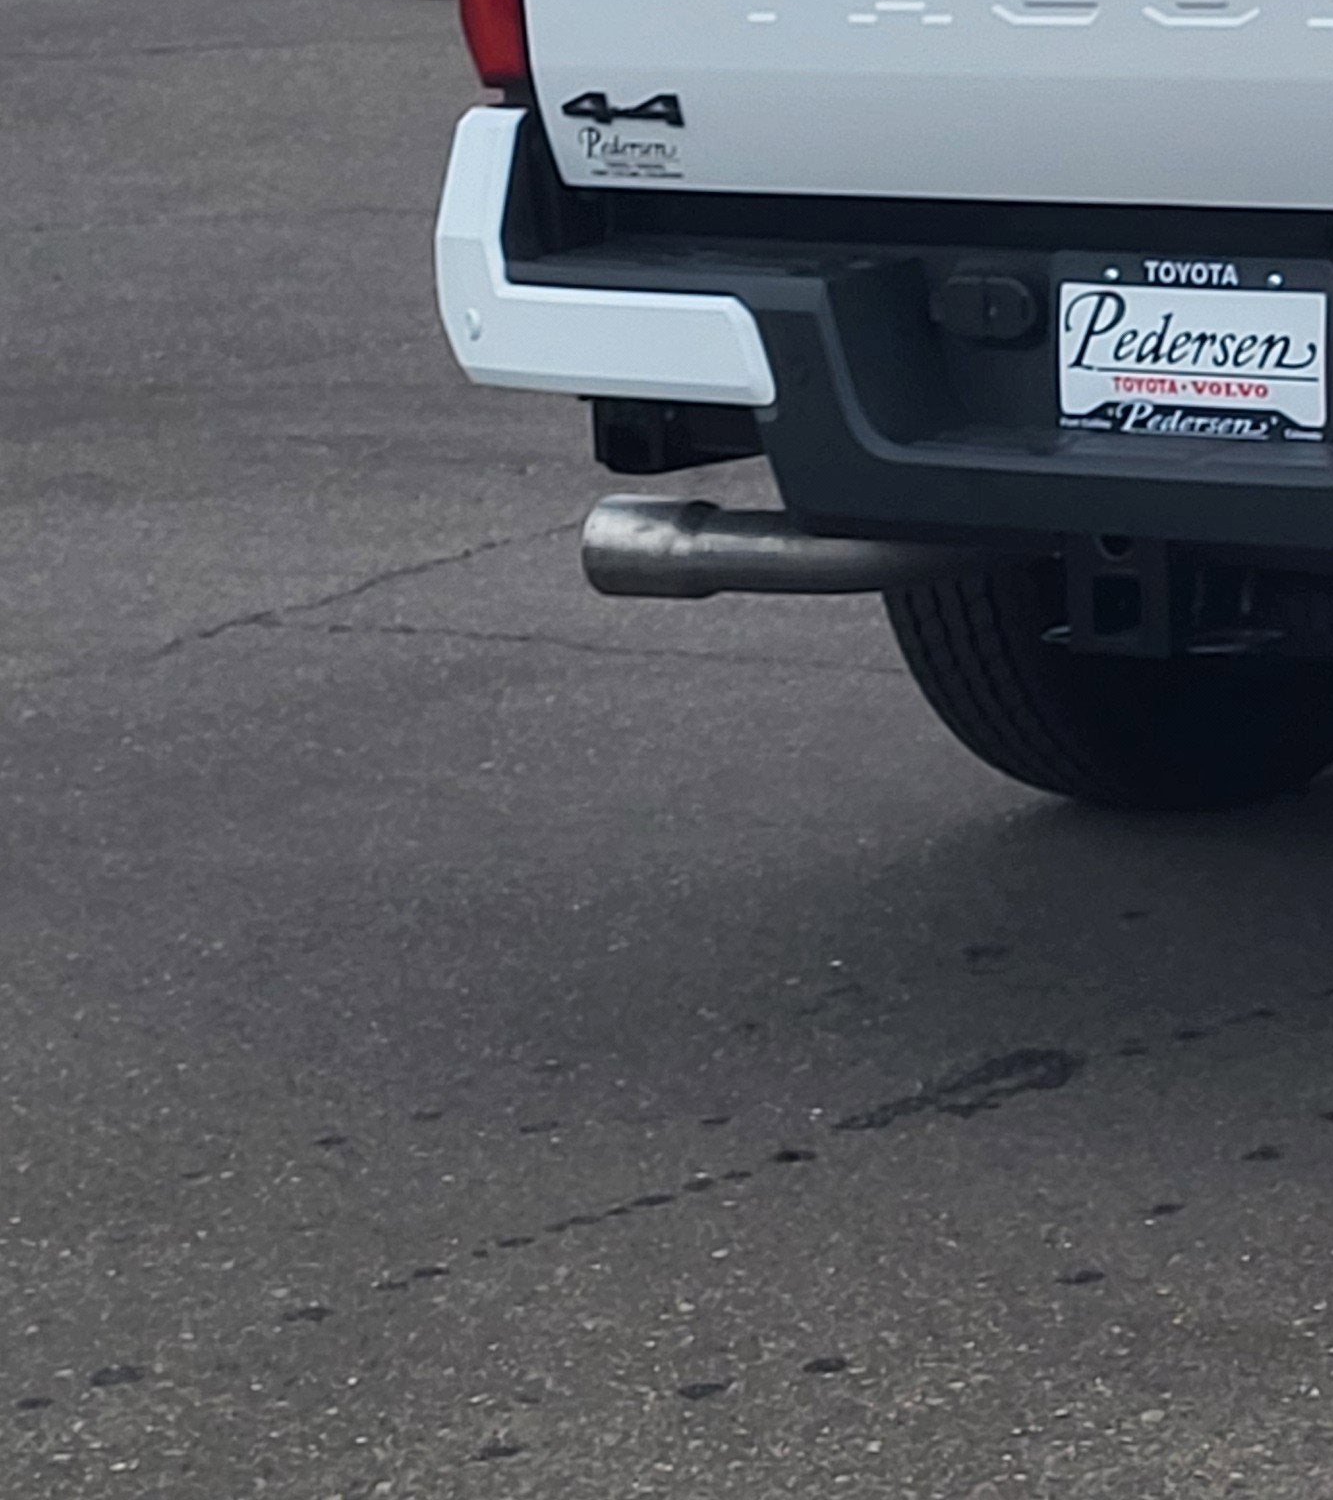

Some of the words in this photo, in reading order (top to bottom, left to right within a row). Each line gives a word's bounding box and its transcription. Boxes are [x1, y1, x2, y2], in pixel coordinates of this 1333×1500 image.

[1144, 260, 1239, 285] TOYOTA
[1065, 290, 1317, 370] Pedersen
[1113, 376, 1177, 394] TOYOTA
[1192, 380, 1268, 398] VOLVO
